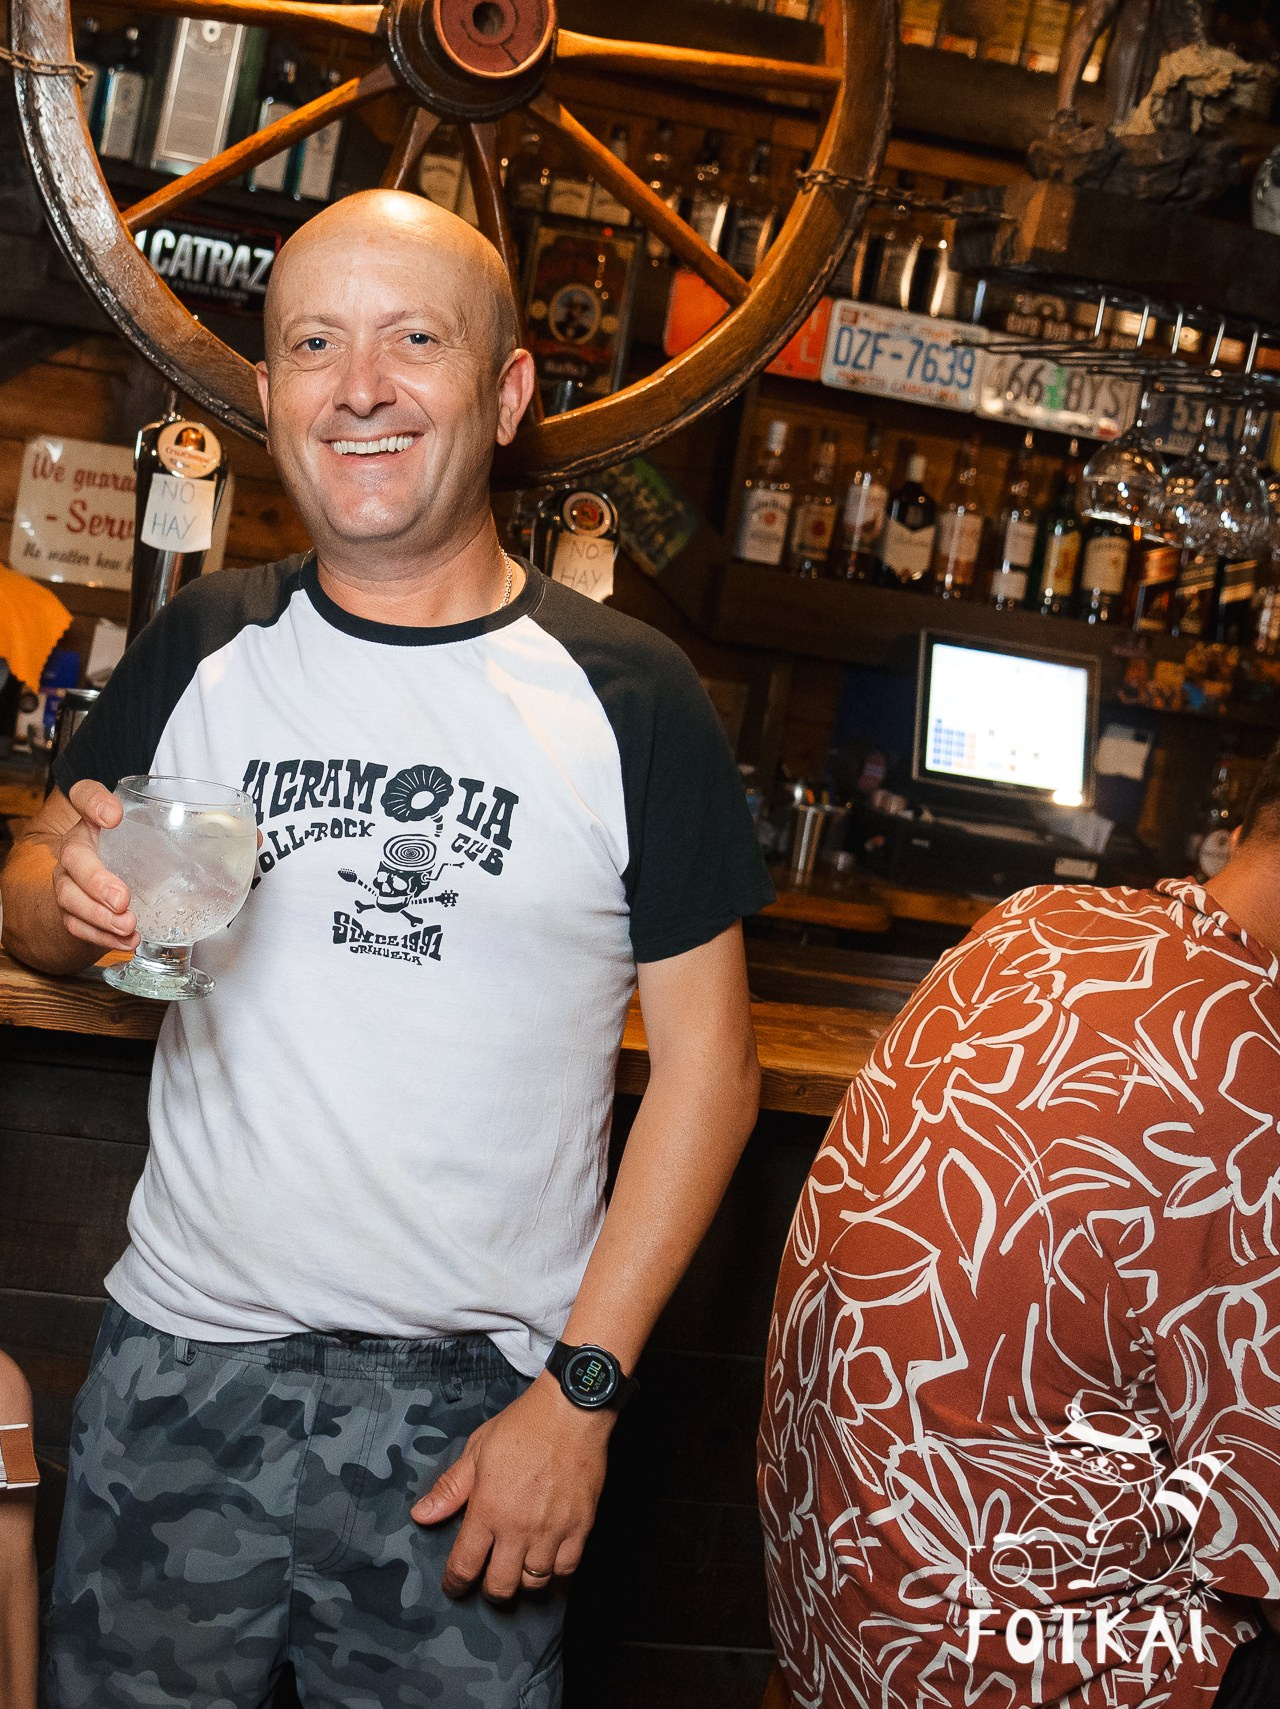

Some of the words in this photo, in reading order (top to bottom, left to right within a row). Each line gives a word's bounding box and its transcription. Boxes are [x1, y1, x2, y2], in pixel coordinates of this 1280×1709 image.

[134, 229, 275, 294] CATRAZ
[31, 453, 66, 483] We
[74, 469, 136, 494] guara
[161, 480, 196, 504] NO
[151, 512, 198, 541] HAY
[570, 540, 600, 560] NO
[560, 566, 604, 594] HAY
[450, 832, 505, 877] CLUB
[332, 911, 400, 947] SINCE
[400, 924, 444, 962] 1991
[349, 945, 423, 966] ORIHUELA
